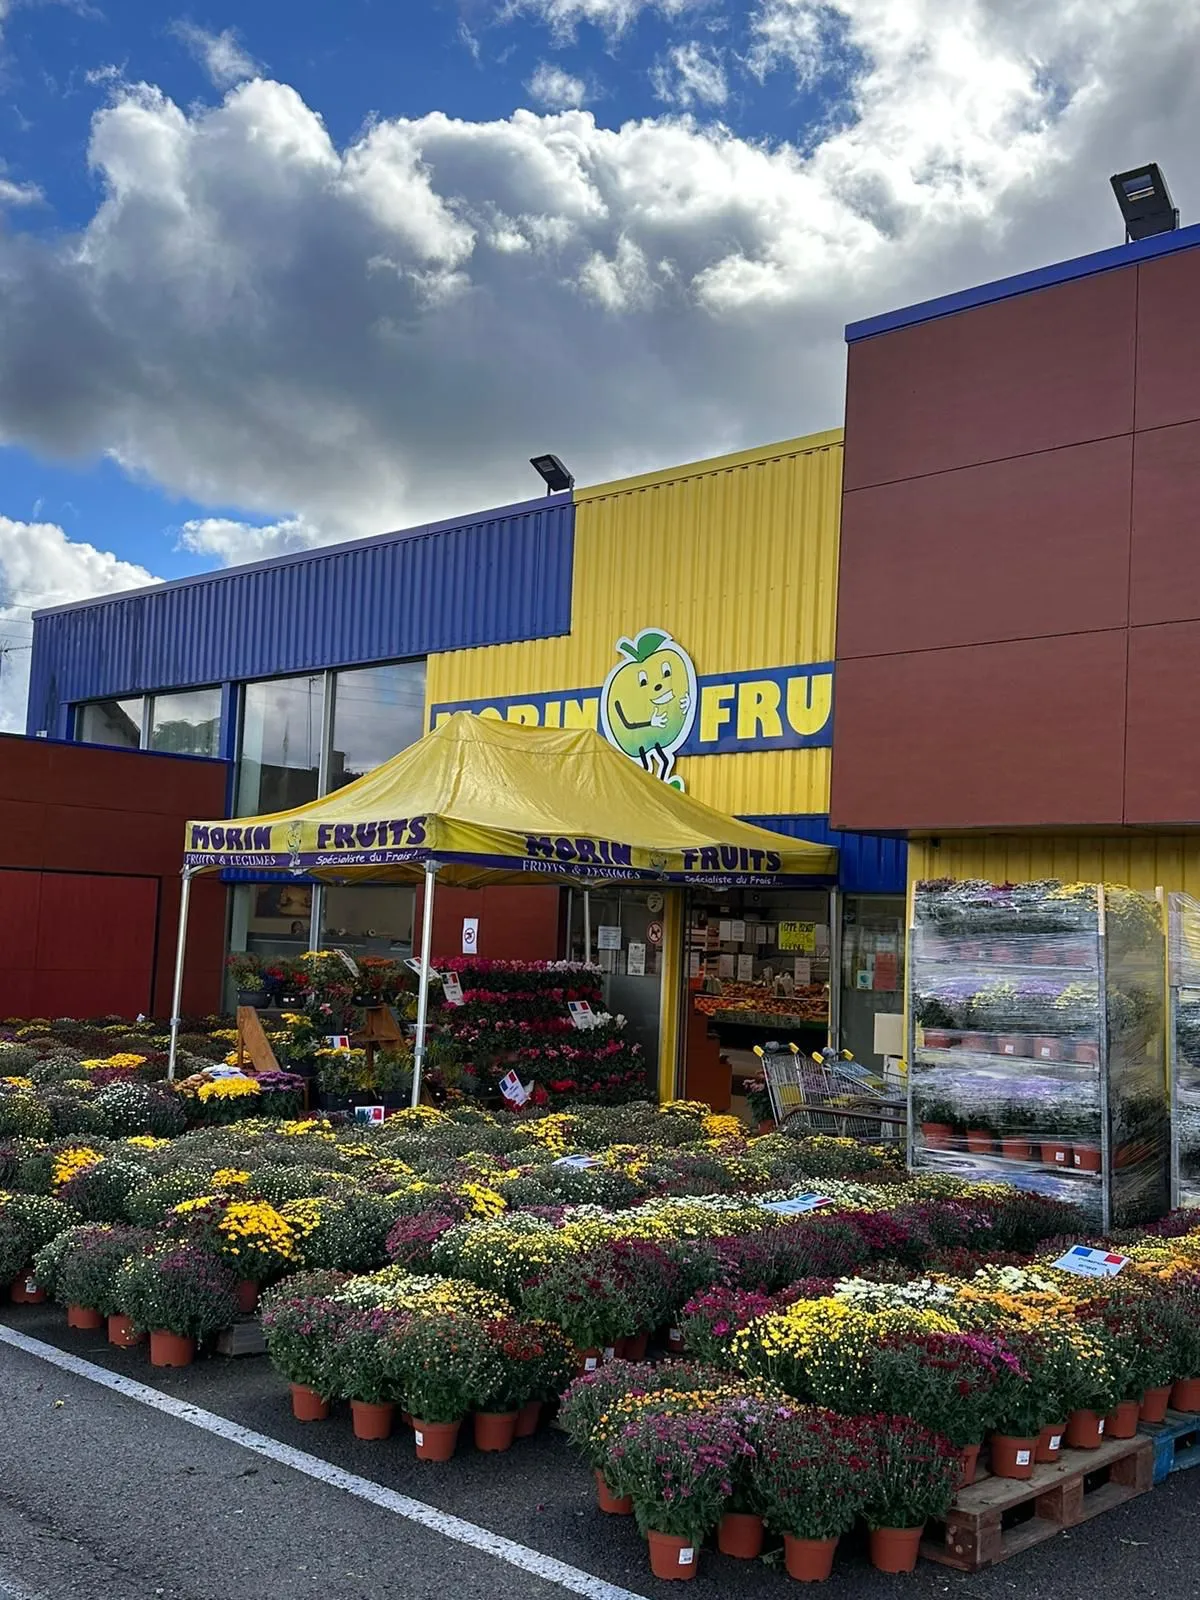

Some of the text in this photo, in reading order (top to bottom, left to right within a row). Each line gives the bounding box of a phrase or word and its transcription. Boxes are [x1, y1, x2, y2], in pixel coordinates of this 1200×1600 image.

[191, 816, 428, 851] MORIN FRUITS
[185, 854, 277, 866] FRUITS & LEGUMES
[316, 854, 366, 866] Spécialiste
[370, 852, 382, 862] du
[525, 836, 782, 872] MORIN FRUITS
[522, 860, 641, 880] FRUITS & LEGUMES
[684, 875, 732, 886] Spécialiste
[736, 875, 747, 885] du
